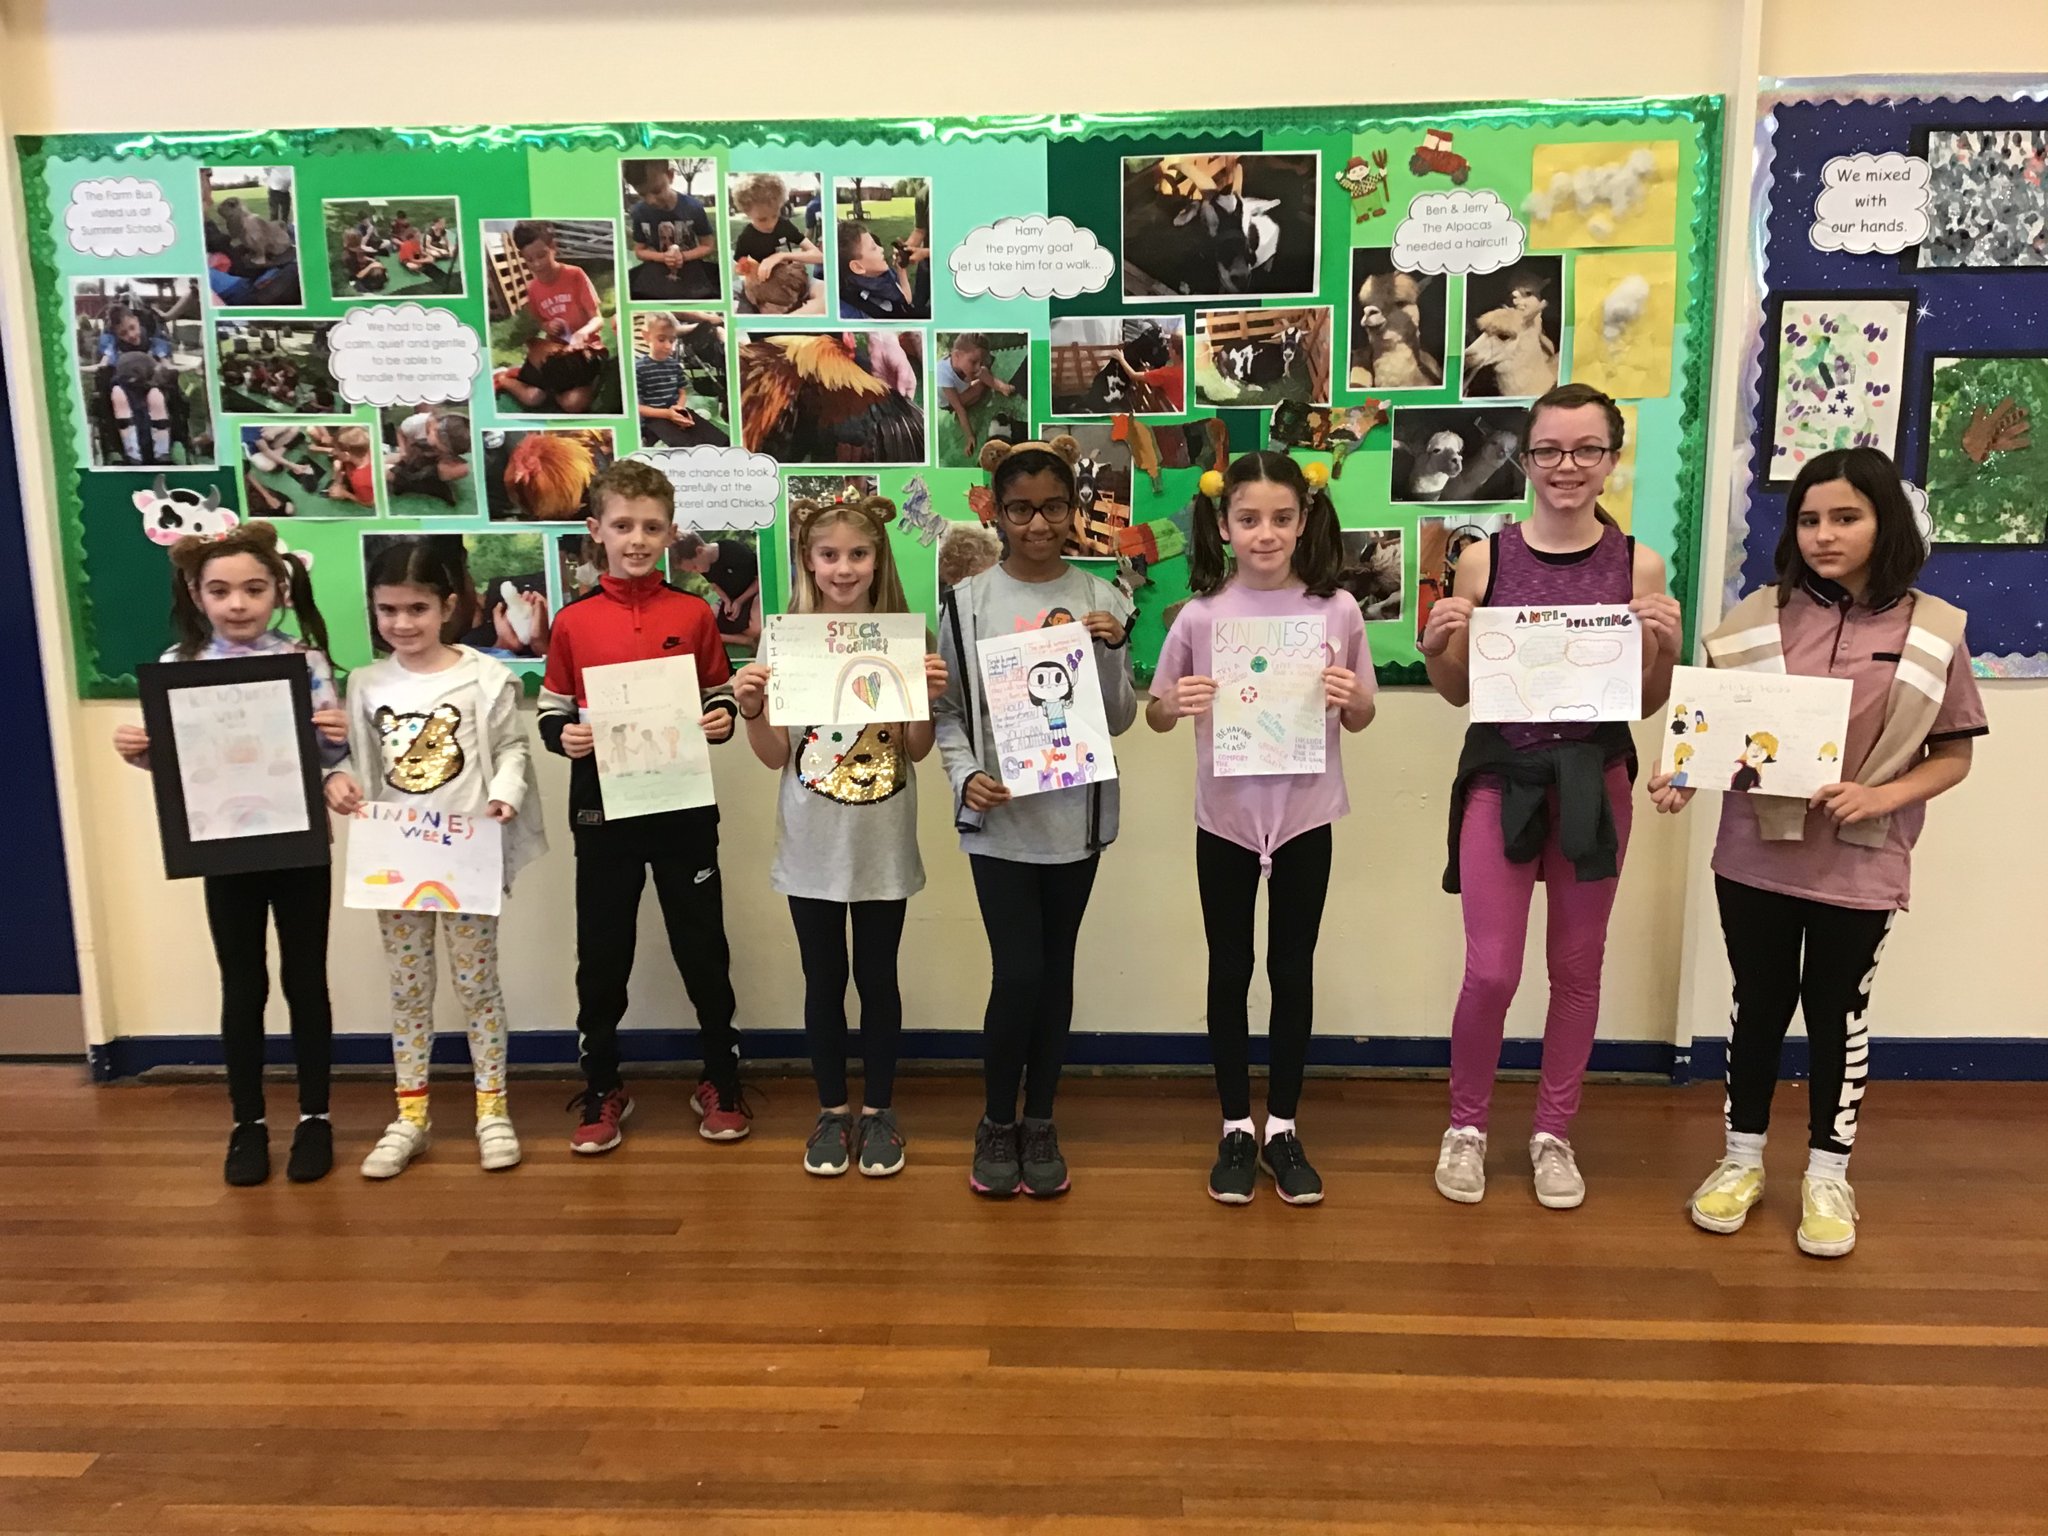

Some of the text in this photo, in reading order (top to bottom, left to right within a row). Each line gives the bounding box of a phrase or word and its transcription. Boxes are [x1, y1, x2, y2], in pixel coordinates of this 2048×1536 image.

[1838, 168, 1911, 182] We mixed
[84, 189, 153, 200] The Farm Bus
[1855, 194, 1887, 207] with
[91, 207, 151, 217] visited us at
[1425, 203, 1489, 216] Ben & Jerry
[81, 226, 124, 236] Summer
[1015, 226, 1044, 237] Harry
[1422, 221, 1493, 234] The Alpacas
[1831, 219, 1908, 233] our hands.
[986, 243, 1074, 255] the pygmy goat
[1406, 236, 1508, 252] needed a haircut!
[957, 261, 972, 271] let
[974, 262, 986, 271] us
[988, 261, 1013, 271] take
[1015, 260, 1036, 271] him
[1038, 260, 1051, 270] for
[1055, 262, 1064, 270] a
[367, 322, 442, 332] We had to be
[377, 339, 405, 350] quiet
[407, 340, 430, 348] and
[432, 338, 467, 350] gentle
[372, 356, 442, 365] to be able to
[356, 373, 394, 382] handle
[396, 372, 412, 381] the
[669, 467, 770, 478] the chance to look
[674, 482, 753, 493] carefully at the
[674, 498, 768, 509] ckerel and Chicks.
[826, 620, 882, 640] STICK
[1215, 620, 1326, 650] KINNESS!
[1216, 726, 1253, 740] BEHAVING
[1001, 756, 1033, 780] Can
[1041, 747, 1067, 774] You
[1037, 762, 1098, 792] Kind?
[399, 826, 452, 846] WEEK
